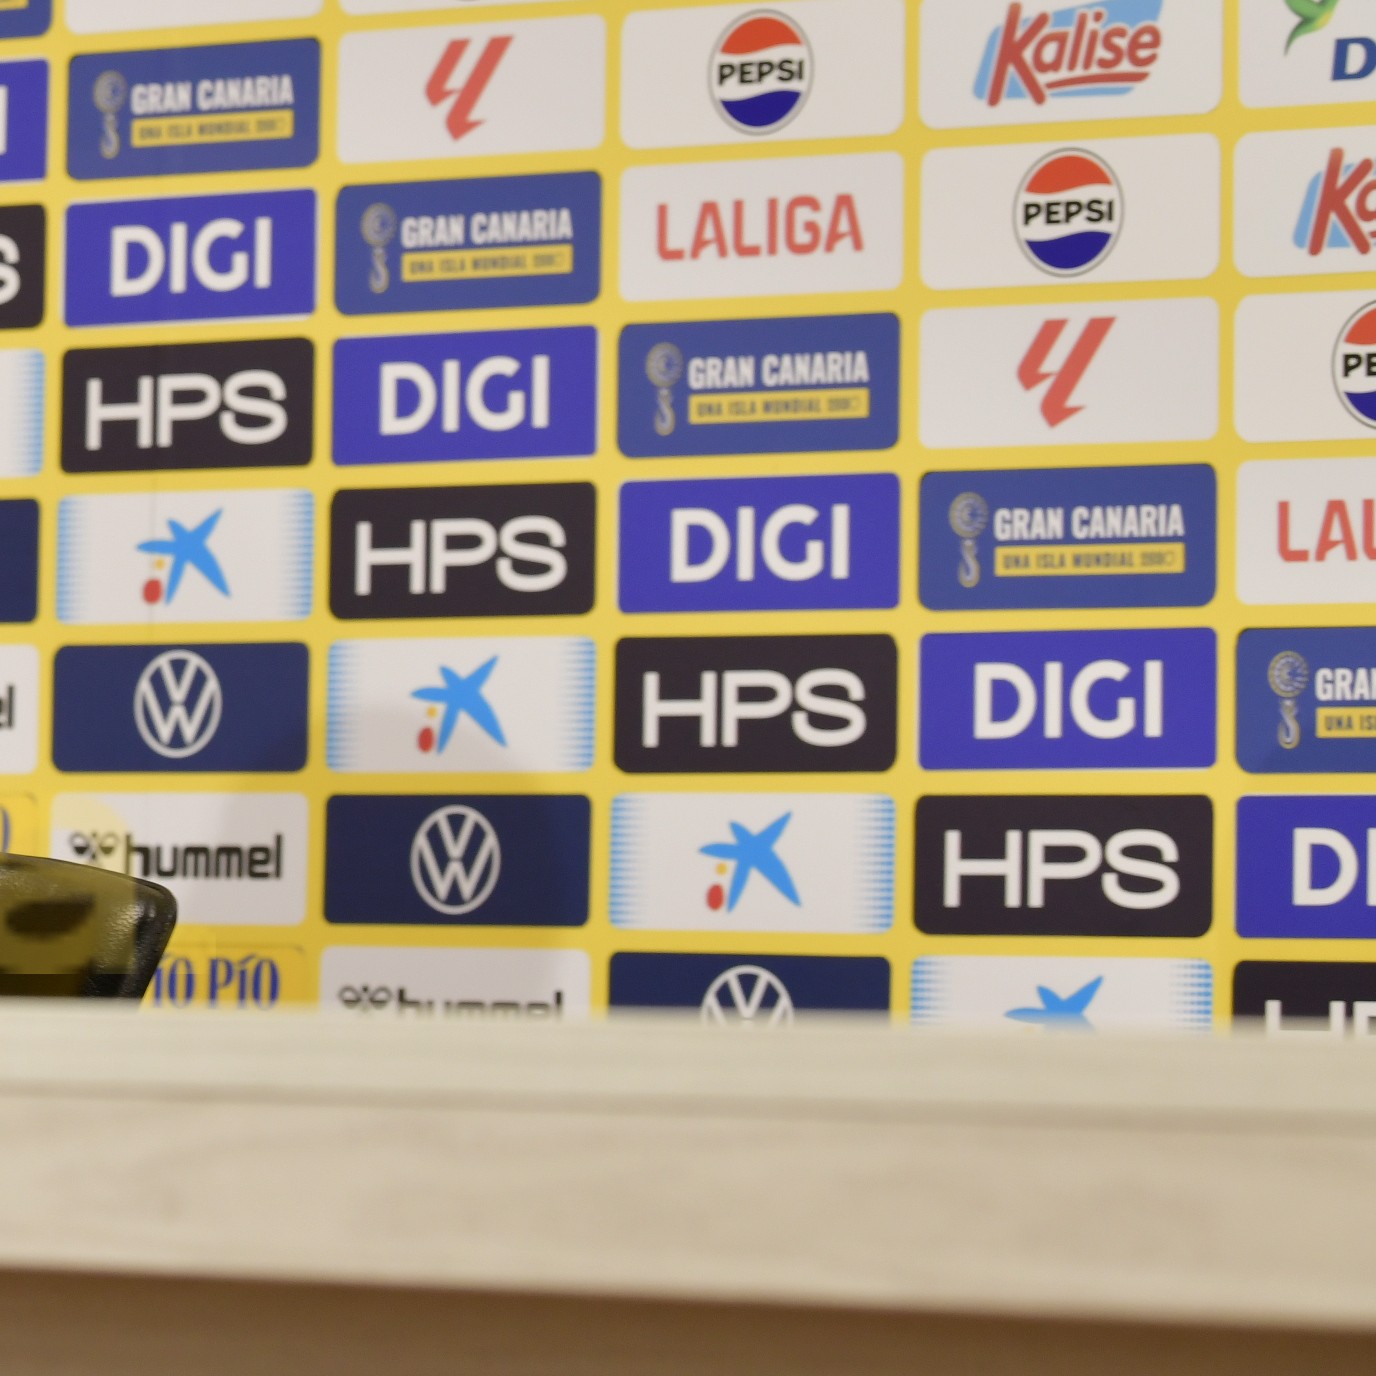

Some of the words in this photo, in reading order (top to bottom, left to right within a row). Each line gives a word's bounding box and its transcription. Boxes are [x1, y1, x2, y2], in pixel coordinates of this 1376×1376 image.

[718, 59, 802, 85] PEPSI
[986, 1, 1162, 107] Kalise
[131, 82, 191, 114] GRAN
[196, 75, 293, 110] CANARIA
[401, 215, 464, 248] GRAN
[470, 208, 572, 244] CANARIA
[657, 194, 862, 260] LALIGA
[1024, 199, 1113, 225] PEPSI
[110, 217, 271, 296] DIGI
[380, 355, 548, 434] DIGI
[688, 356, 754, 389] GRAN
[761, 351, 868, 386] CANARIA
[86, 370, 286, 449] HPS
[356, 515, 566, 594] HPS
[670, 504, 848, 582] DIGI
[994, 507, 1063, 540] GRAN
[1071, 504, 1184, 538] CANARIA
[643, 668, 865, 746] HPS
[974, 660, 1161, 738] DIGI
[1315, 667, 1376, 701] GRA
[125, 834, 283, 879] hummel
[944, 829, 1178, 908] HPS
